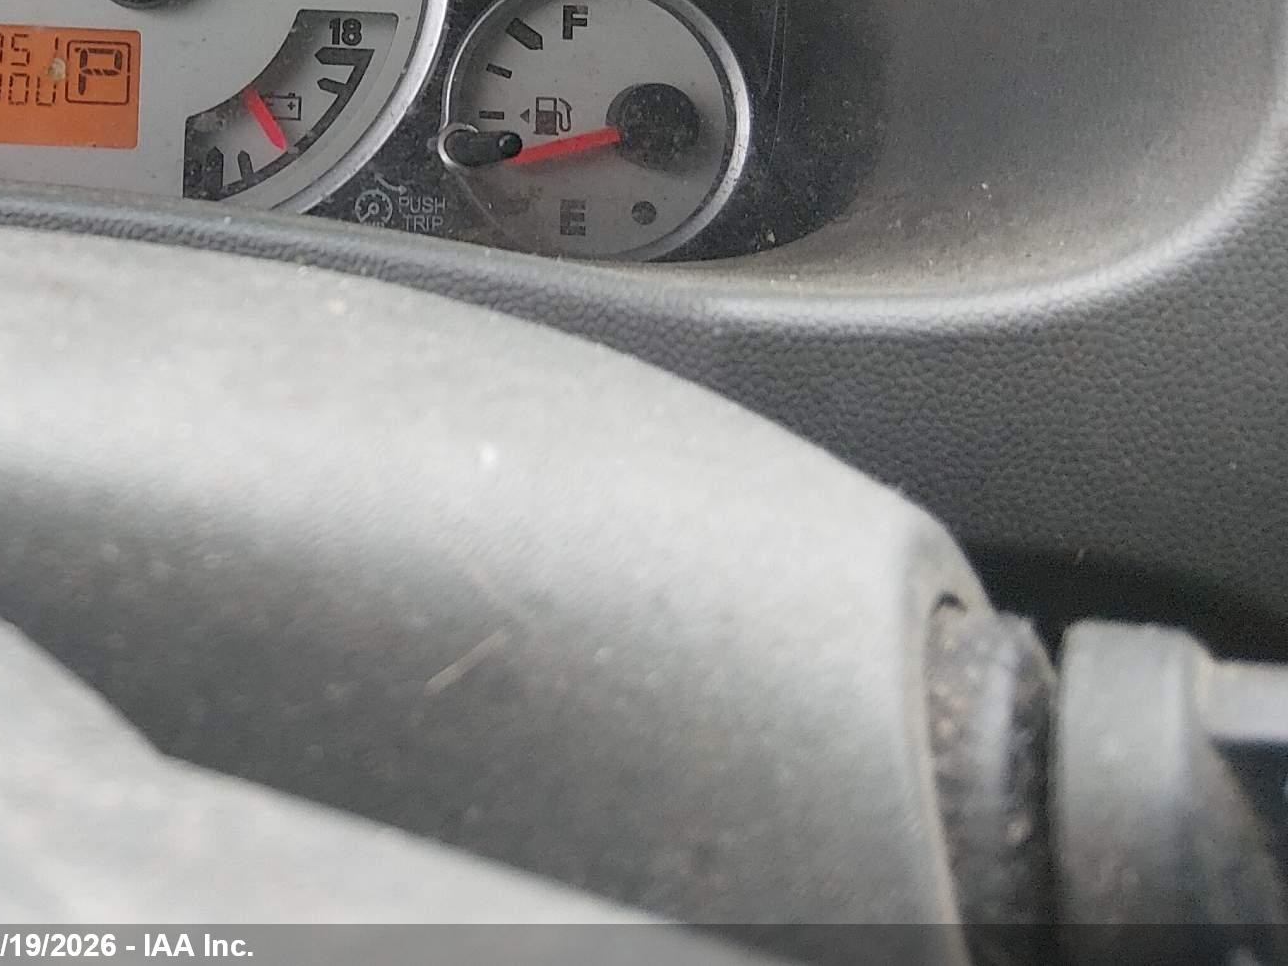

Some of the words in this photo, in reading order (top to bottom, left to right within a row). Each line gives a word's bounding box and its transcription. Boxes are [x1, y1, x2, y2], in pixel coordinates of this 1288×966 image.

[329, 19, 362, 45] 18
[563, 5, 588, 40] F
[75, 47, 123, 96] P
[398, 196, 446, 214] PUSH
[560, 199, 586, 235] E
[403, 215, 444, 232] TRIP
